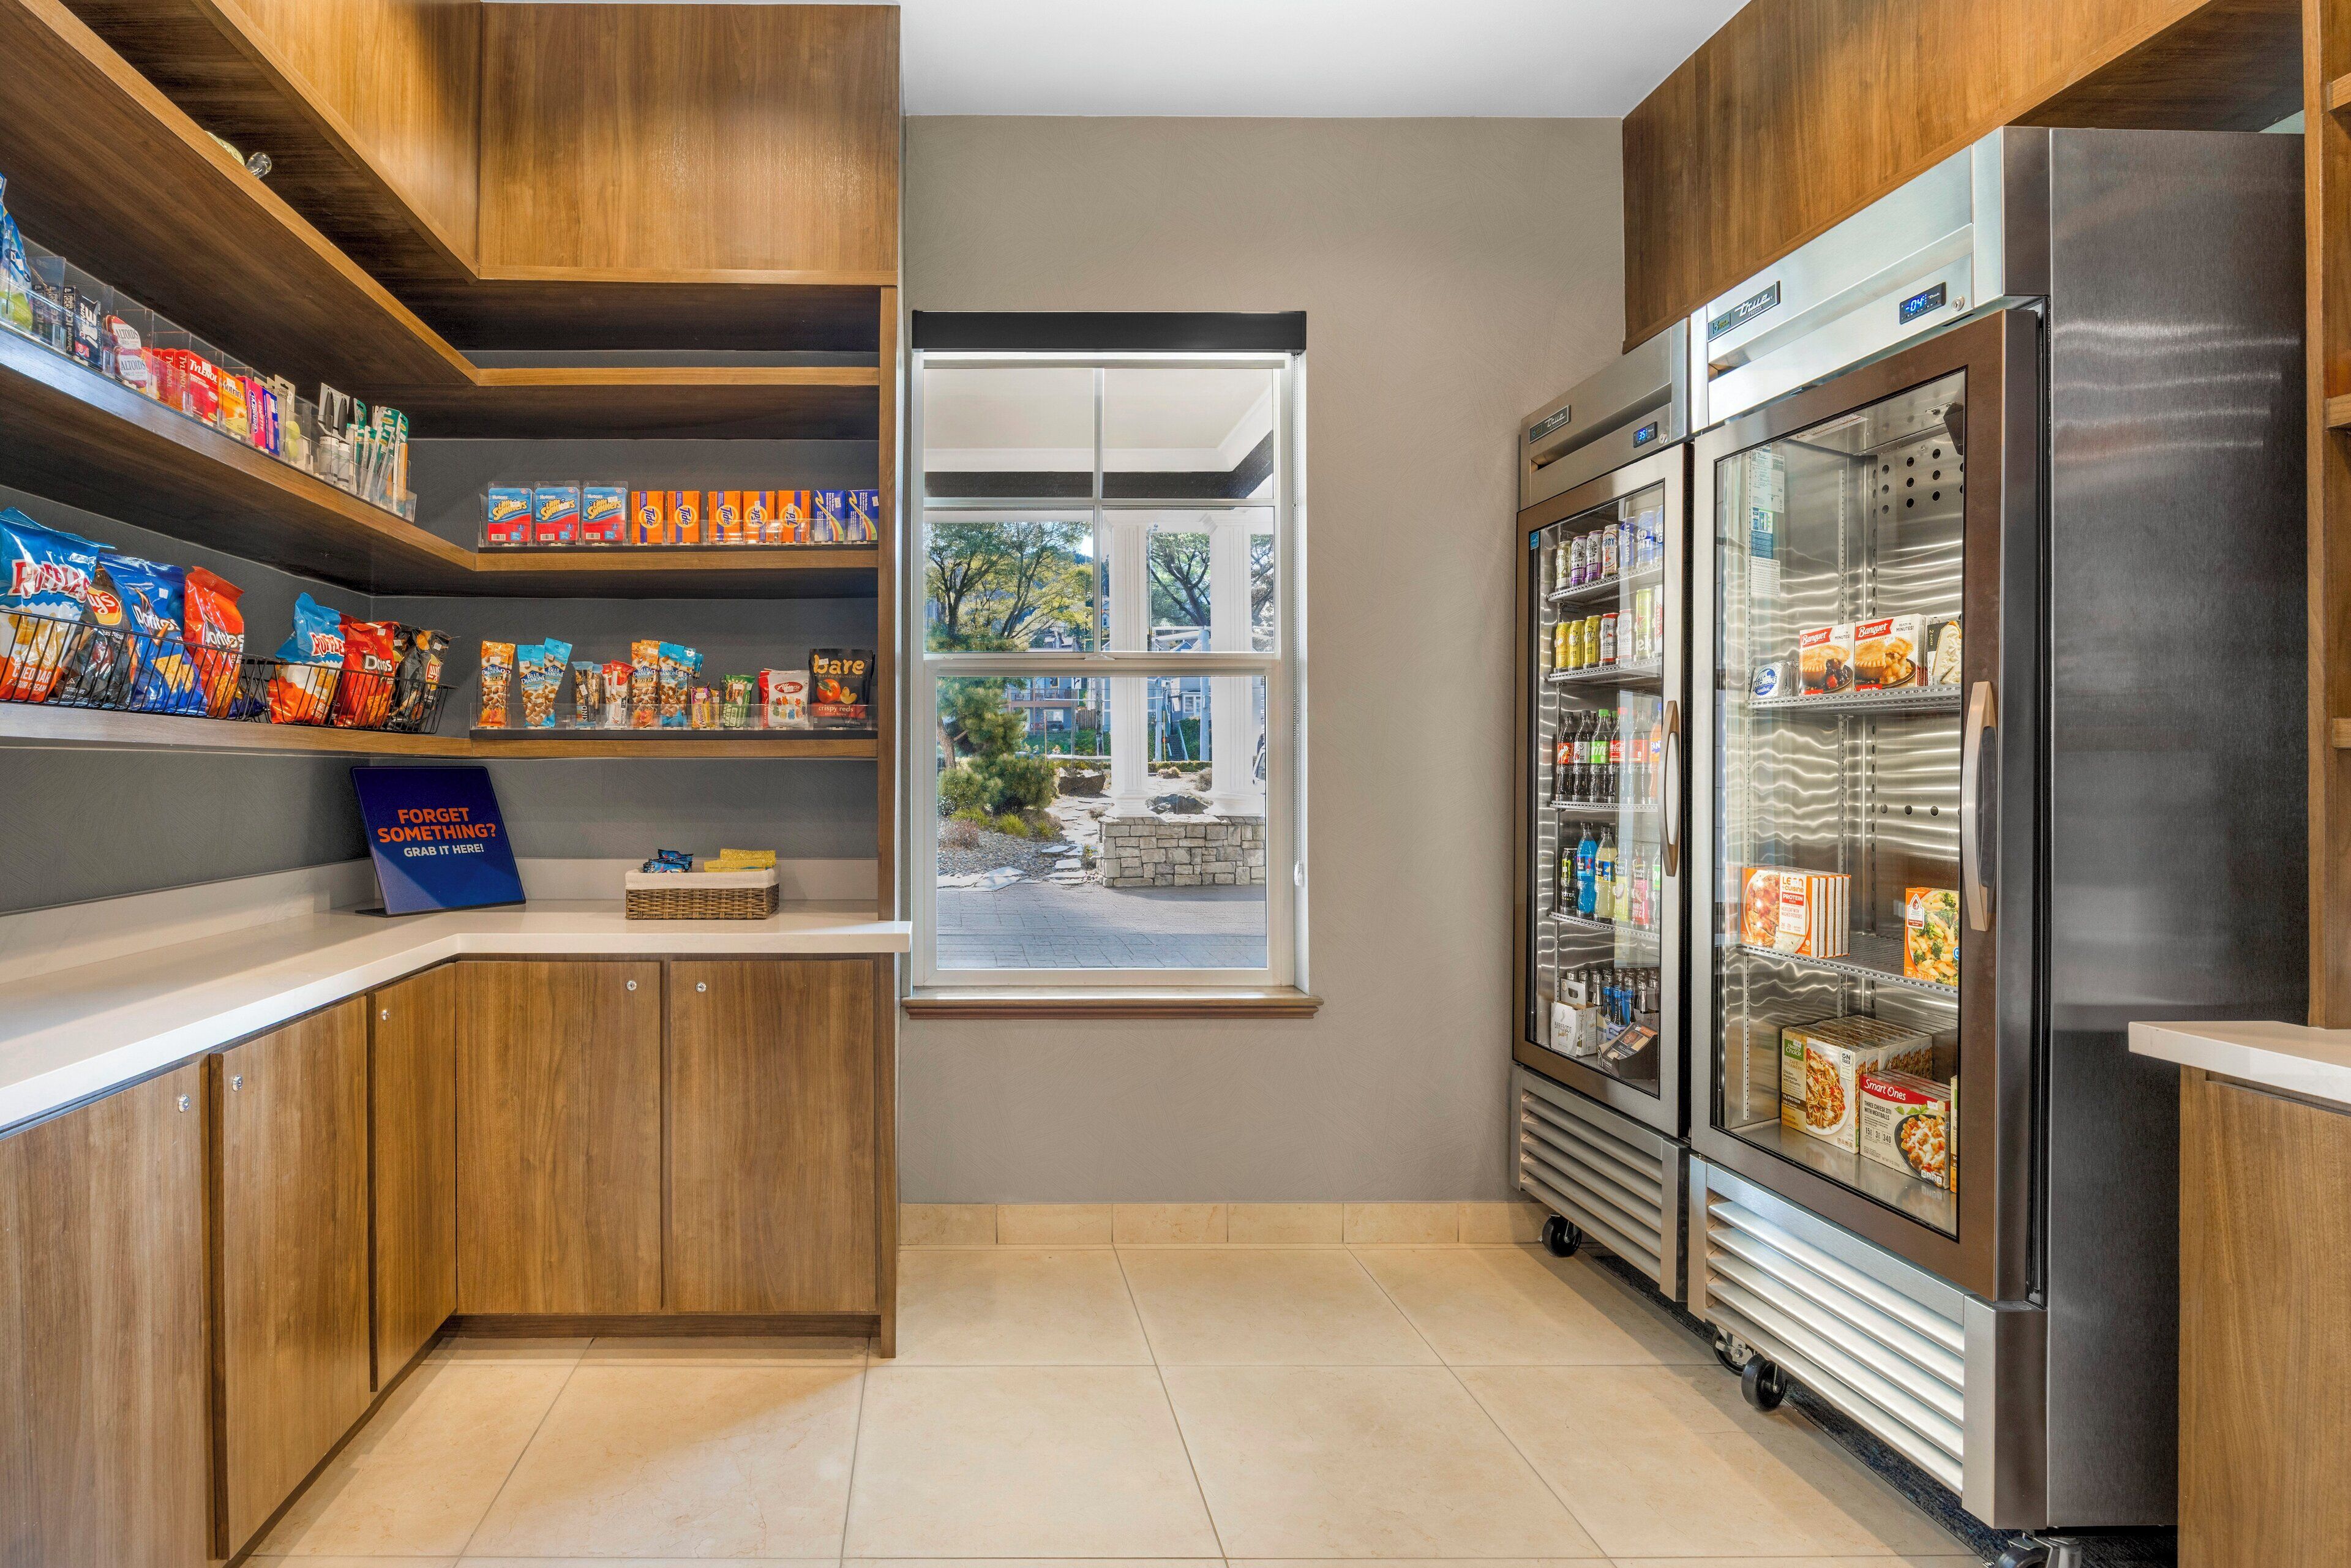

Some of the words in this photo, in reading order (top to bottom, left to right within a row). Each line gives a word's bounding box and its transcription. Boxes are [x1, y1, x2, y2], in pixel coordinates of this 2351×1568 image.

[116, 328, 139, 339] ALTOIDS
[121, 358, 146, 371] ALTOIDS
[190, 359, 218, 383] TYLENOL
[1638, 430, 1646, 440] 35
[643, 508, 656, 527] Tide
[678, 507, 691, 526] Tide
[720, 507, 733, 525] Tide
[786, 509, 798, 526] Tid
[9, 560, 91, 603] RUFFLES
[133, 604, 181, 631] Doritos
[1858, 623, 1889, 638] Banquet
[1802, 631, 1828, 646] Banquet
[813, 654, 866, 675] bare
[1752, 675, 1778, 691] KLONDIKE
[818, 705, 838, 713] crispy
[398, 807, 469, 824] FORGET
[377, 823, 497, 843] SOMETHING?
[403, 846, 437, 857] GRAB
[439, 846, 449, 855] IT
[452, 843, 484, 854] HERE!
[1554, 1021, 1572, 1033] BAREFOOT
[1785, 1047, 1801, 1057] Choice
[1842, 1052, 1851, 1061] ON
[1784, 1062, 1802, 1071] STEAMERS
[1864, 1079, 1886, 1095] Smart
[1887, 1087, 1907, 1101] Ones
[1788, 1095, 1801, 1104] PROTEIN
[1872, 1109, 1890, 1121] MEATBALLS
[1874, 1103, 1885, 1112] CHEESE
[1883, 1134, 1891, 1144] 340
